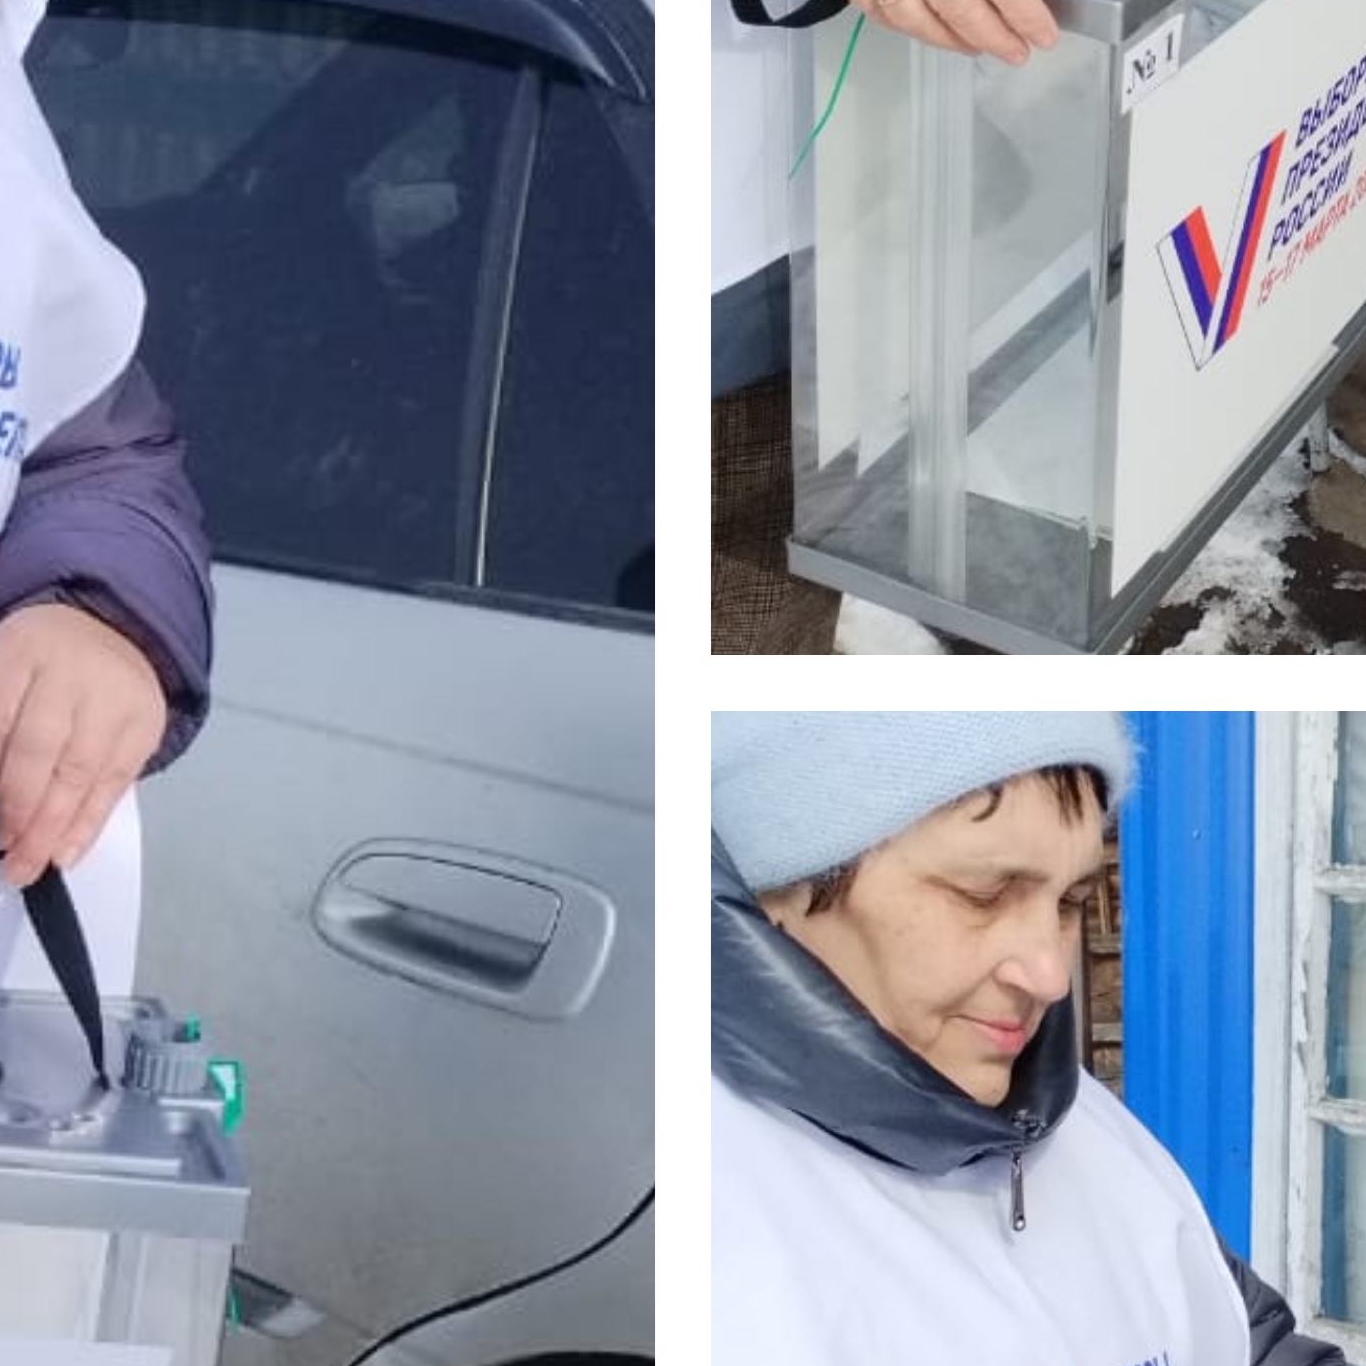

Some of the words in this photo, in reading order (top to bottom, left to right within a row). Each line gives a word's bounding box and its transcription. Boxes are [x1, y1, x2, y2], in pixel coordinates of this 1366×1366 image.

[1126, 51, 1158, 95] №
[1164, 31, 1175, 64] 1
[1267, 147, 1354, 261] РОССИИ
